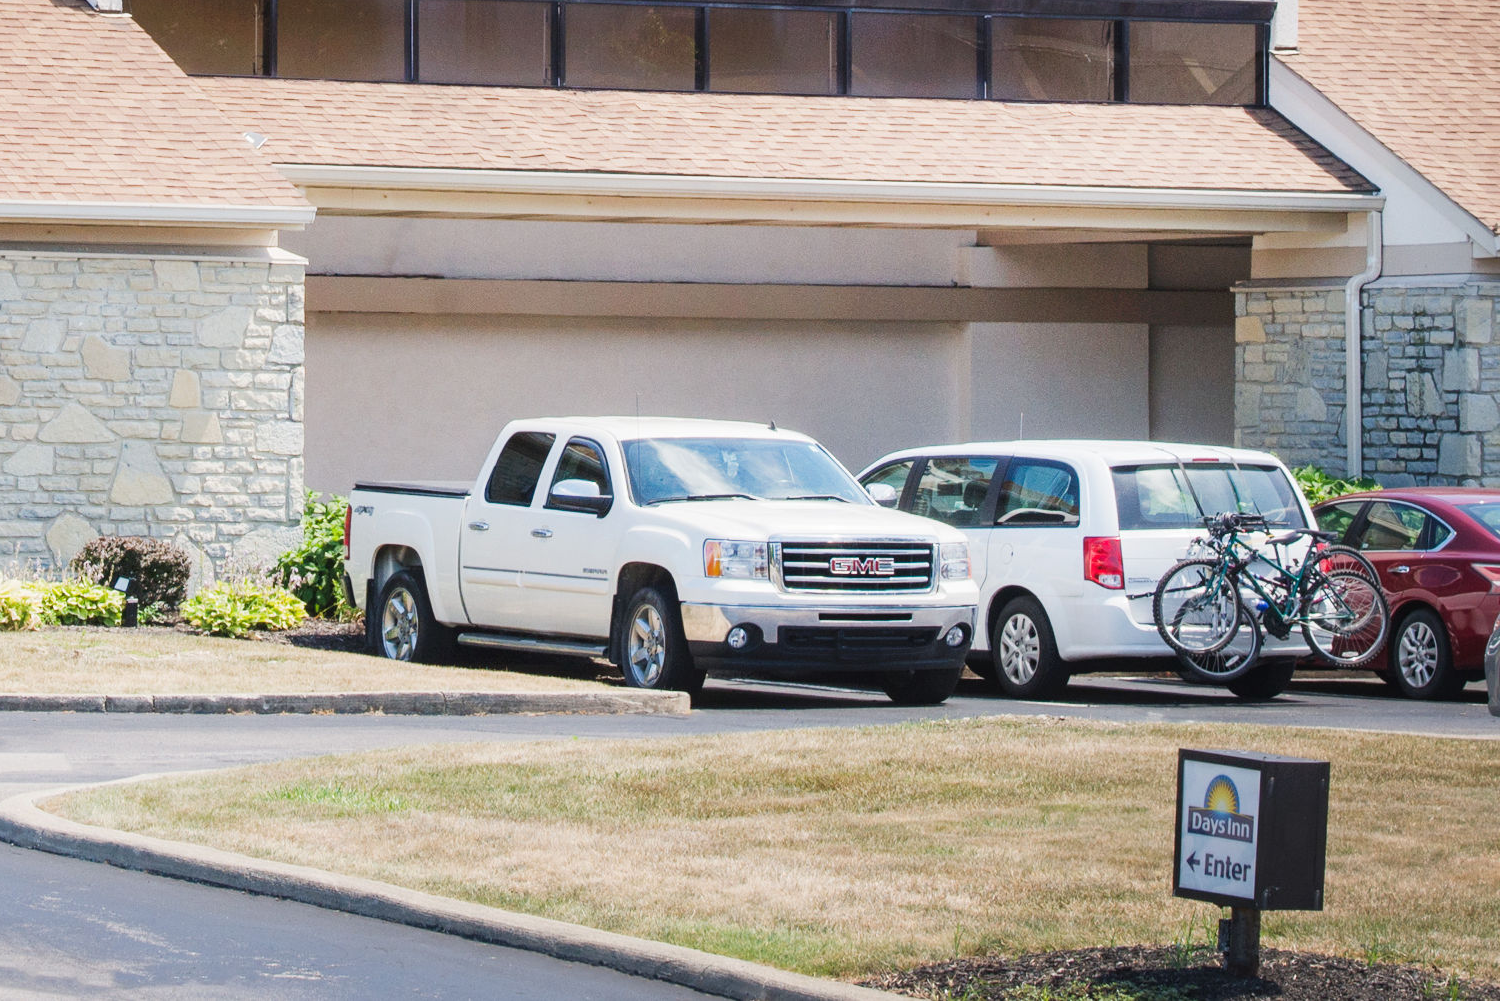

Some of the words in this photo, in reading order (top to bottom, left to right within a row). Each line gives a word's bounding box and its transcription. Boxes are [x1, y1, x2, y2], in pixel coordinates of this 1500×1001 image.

[830, 557, 895, 575] GMC
[1191, 811, 1226, 835] Days
[1227, 817, 1250, 838] Inn
[1204, 853, 1252, 882] Enter
